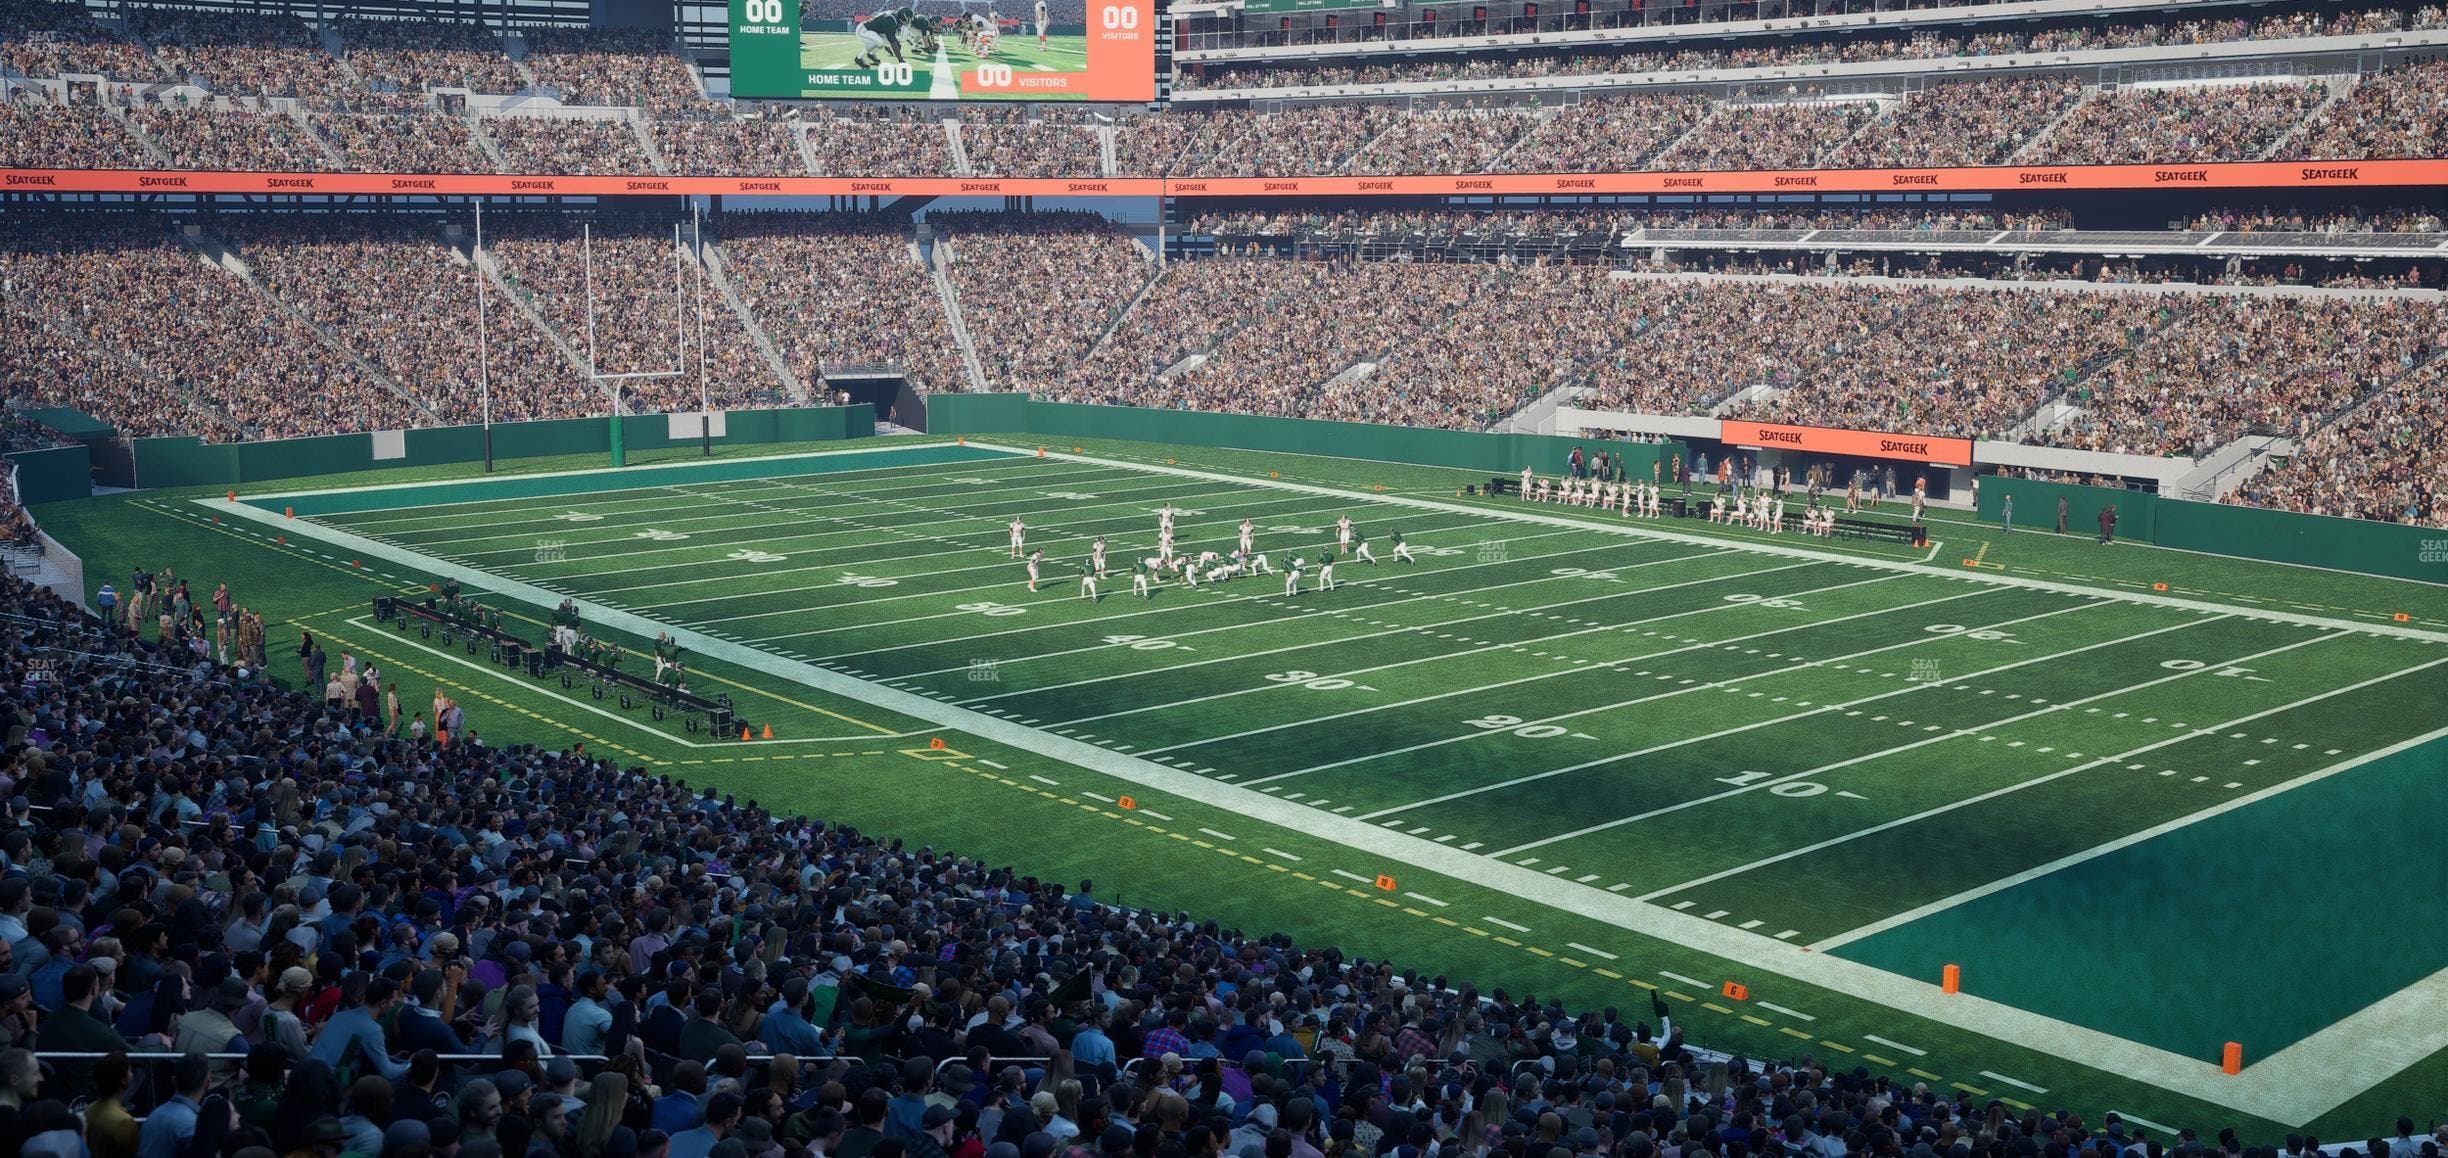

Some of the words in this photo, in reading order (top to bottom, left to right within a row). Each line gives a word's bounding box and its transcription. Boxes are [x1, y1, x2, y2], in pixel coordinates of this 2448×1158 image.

[745, 0, 783, 23] 00
[1102, 5, 1138, 29] 00
[740, 25, 764, 34] HOME
[766, 26, 790, 35] TEAM
[1101, 32, 1139, 40] VISITORS
[877, 62, 913, 86] 00
[977, 63, 1012, 87] 00
[808, 75, 839, 85] HOME
[841, 75, 871, 85] TEAM
[1019, 78, 1067, 87] VISITORS
[2019, 172, 2067, 184] SEATGEEK
[2155, 170, 2208, 182] SEATGEEK
[2301, 167, 2359, 181] SEATGEEK
[5, 174, 56, 186] SEATGEEK
[138, 176, 188, 188] SEATGEEK
[266, 178, 314, 189] SEATGEEK
[391, 179, 436, 189] SEATGEEK
[511, 180, 554, 190] SEATGEEK
[1455, 180, 1492, 190] SEATGEEK
[1557, 179, 1595, 189] SEATGEEK
[1663, 178, 1703, 188] SEATGEEK
[1775, 176, 1817, 187] SEATGEEK
[1893, 174, 1938, 186] SEATGEEK
[627, 181, 669, 191] SEATGEEK
[740, 182, 781, 191] SEATGEEK
[851, 183, 891, 192] SEATGEEK
[960, 183, 1000, 192] SEATGEEK
[1068, 183, 1108, 192] SEATGEEK
[1264, 183, 1298, 191] SEATGEEK
[1358, 182, 1393, 190] SEATGEEK
[1759, 429, 1802, 445] SEATGEEK
[1880, 439, 1928, 456] SEATGEEK
[1101, 633, 1178, 651] 40
[1265, 670, 1354, 691] 30
[1463, 715, 1567, 739] 20
[1713, 770, 1829, 798] 10
[1730, 985, 1737, 996] G
